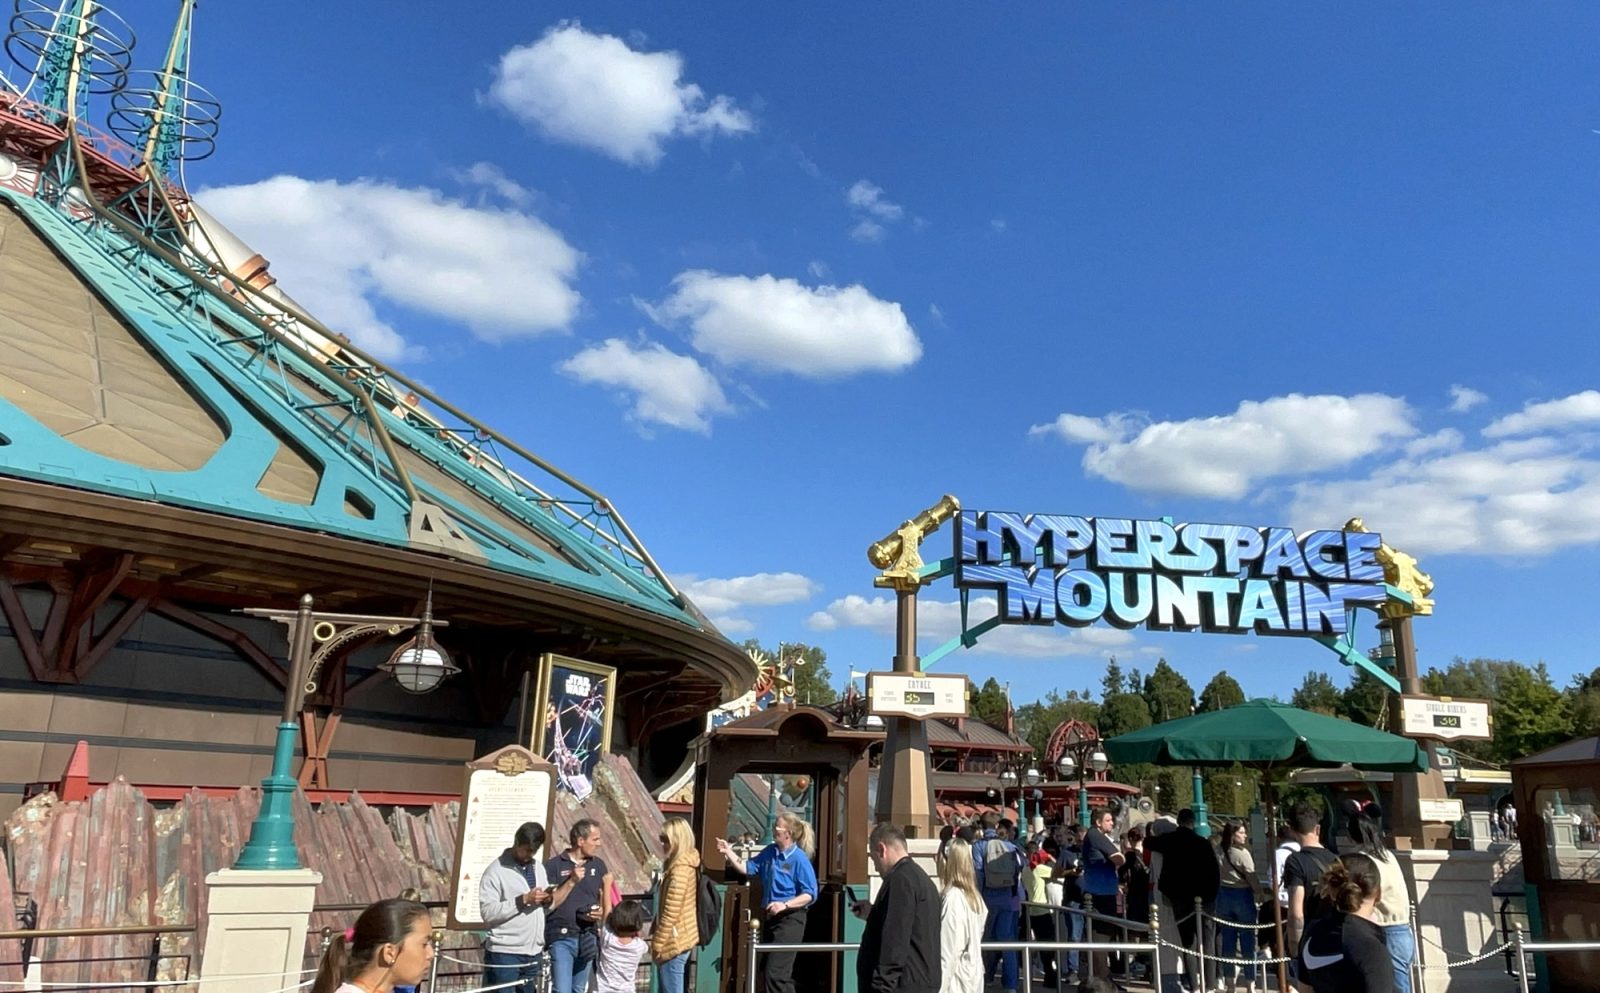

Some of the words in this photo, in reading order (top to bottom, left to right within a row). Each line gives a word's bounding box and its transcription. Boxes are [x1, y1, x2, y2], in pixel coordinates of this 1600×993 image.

[955, 510, 1386, 581] HYPERSPACE
[957, 566, 1388, 634] MOUNTAIN
[565, 674, 591, 687] STAR
[565, 684, 591, 697] WARS
